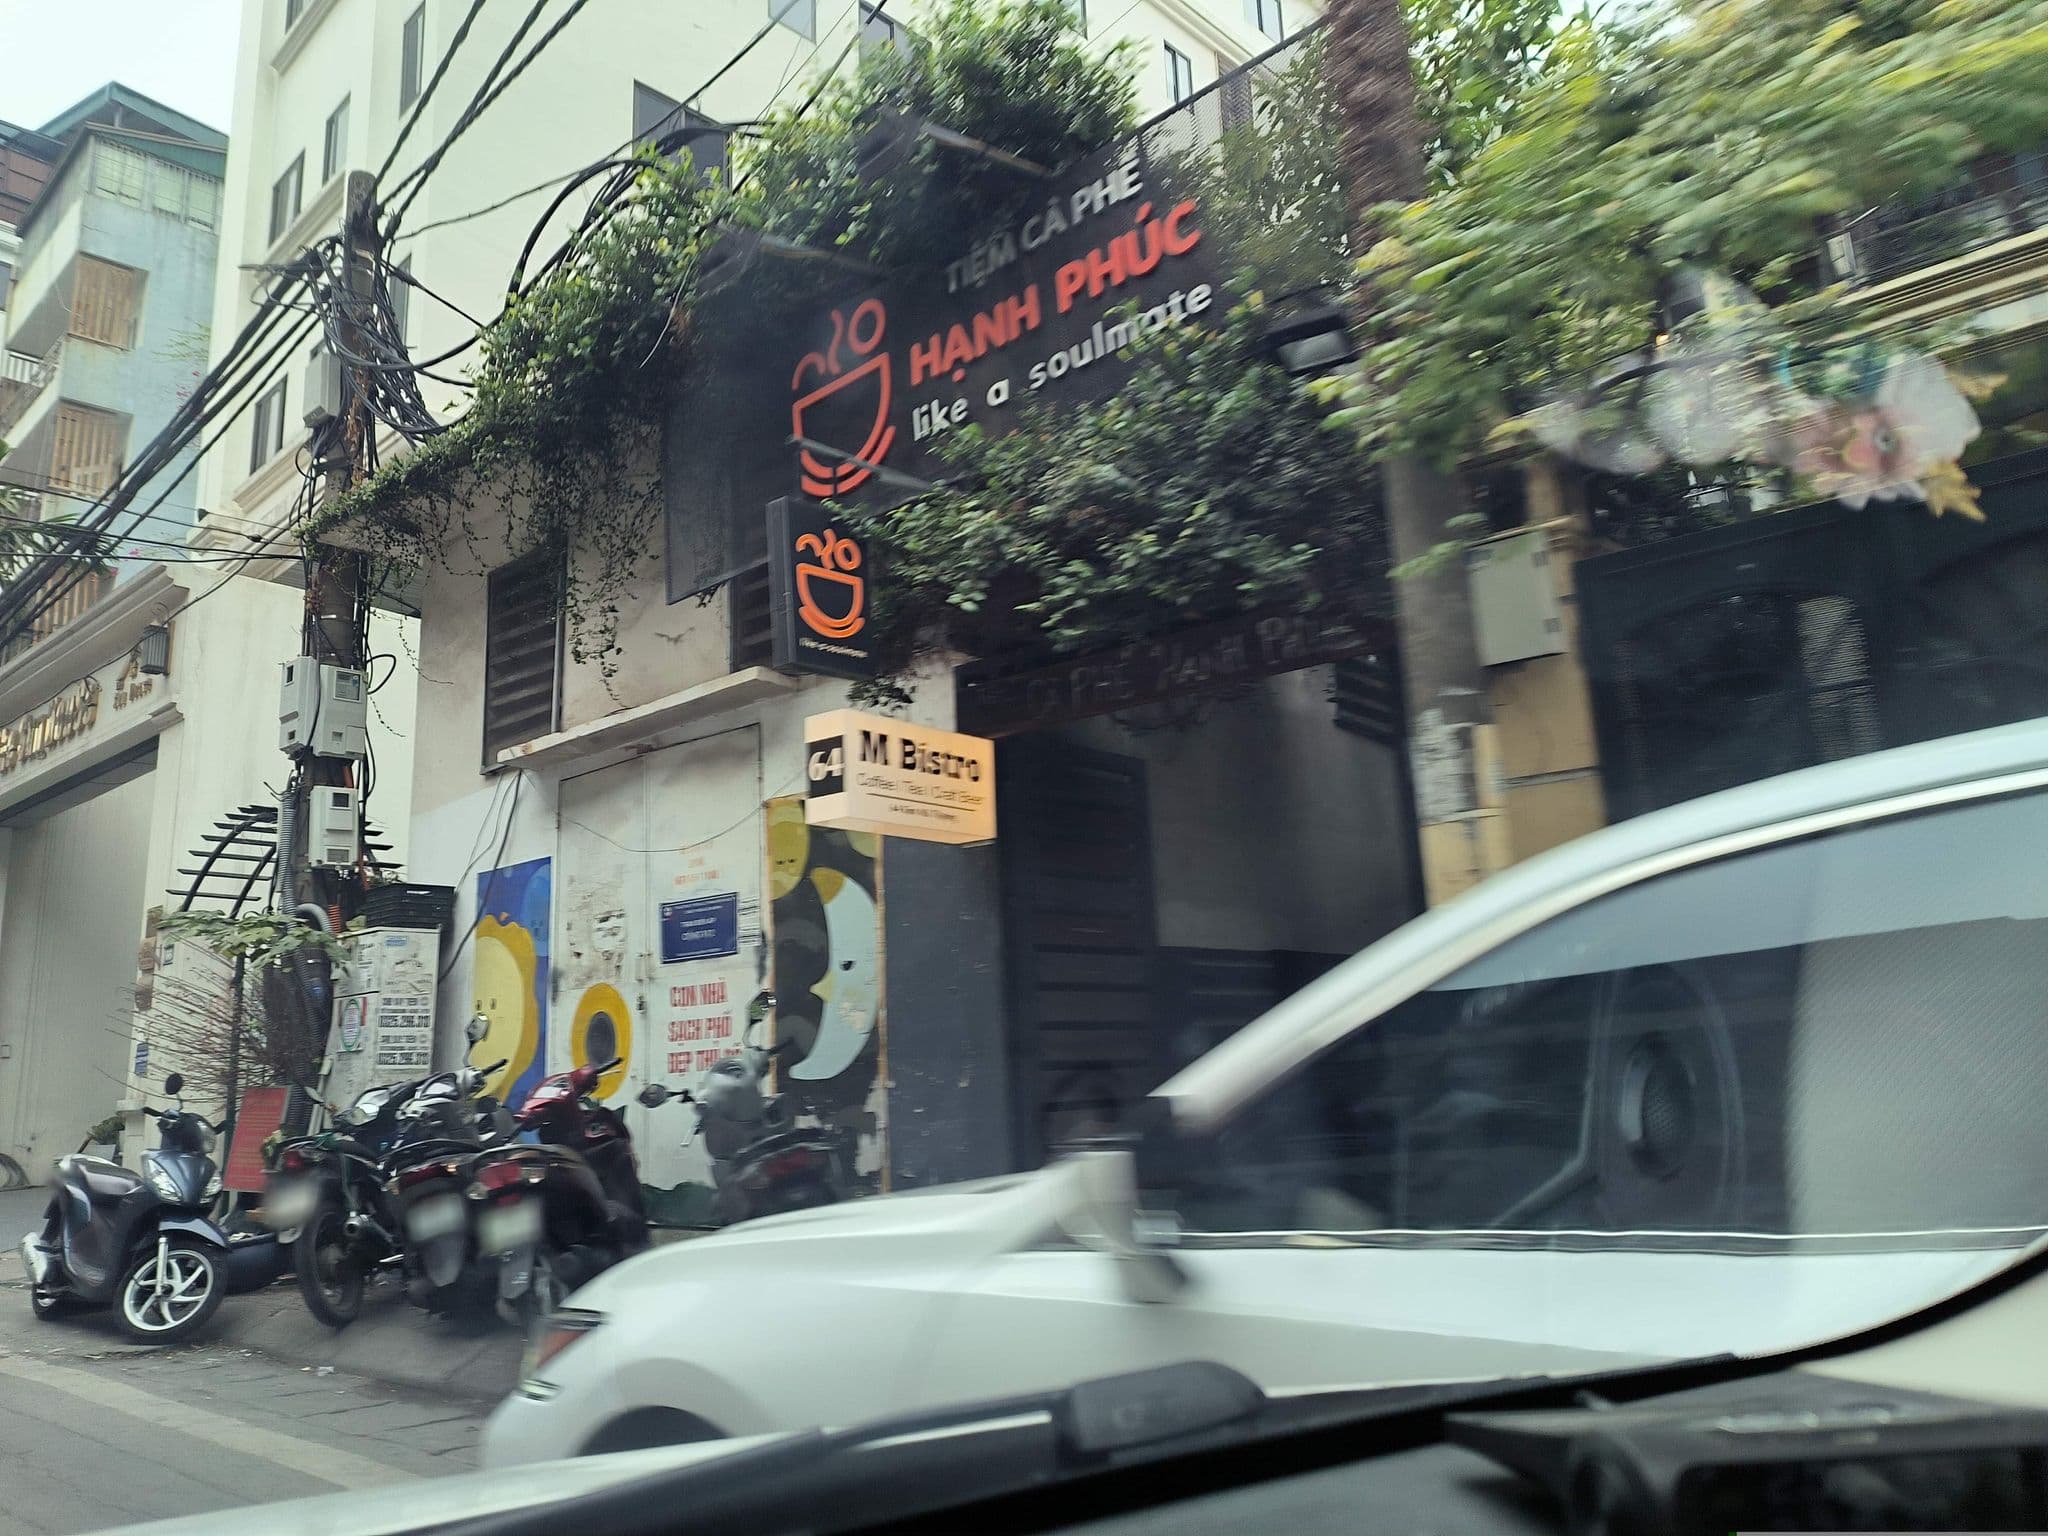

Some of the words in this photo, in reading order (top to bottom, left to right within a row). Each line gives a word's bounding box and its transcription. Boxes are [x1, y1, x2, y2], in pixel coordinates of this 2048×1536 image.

[910, 283, 1041, 386] HẠNH
[1055, 200, 1201, 314] PHÚC
[912, 397, 968, 441] like
[987, 379, 1010, 407] a
[1028, 283, 1212, 390] soulmate
[808, 747, 845, 781] 64
[859, 730, 888, 766] M
[899, 737, 981, 783] Bistro
